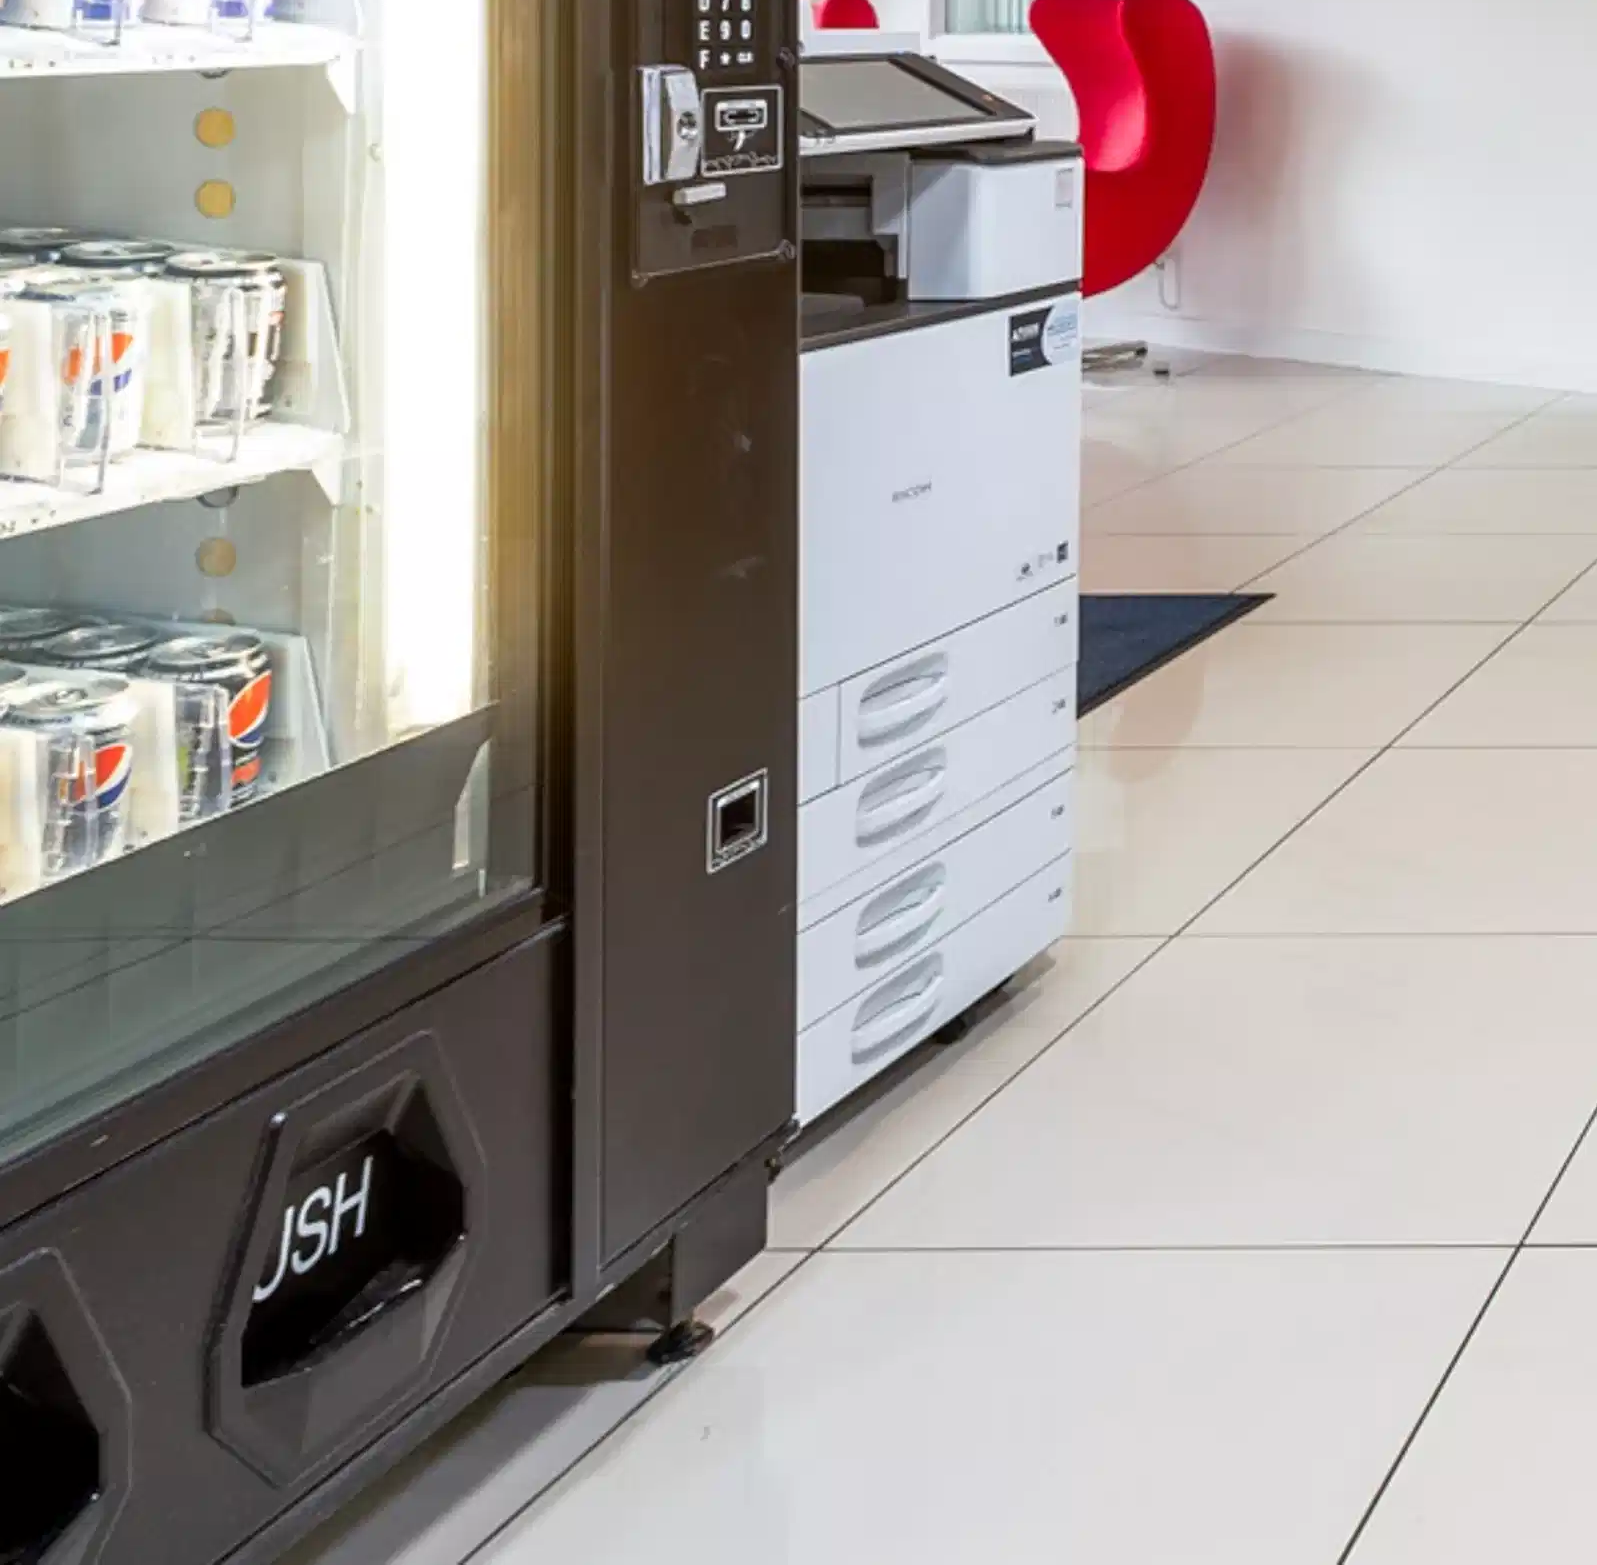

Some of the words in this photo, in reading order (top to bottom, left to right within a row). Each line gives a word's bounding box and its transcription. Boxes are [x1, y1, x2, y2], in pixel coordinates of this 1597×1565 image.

[699, 19, 711, 41] E
[719, 19, 731, 41] 9
[699, 48, 711, 70] F
